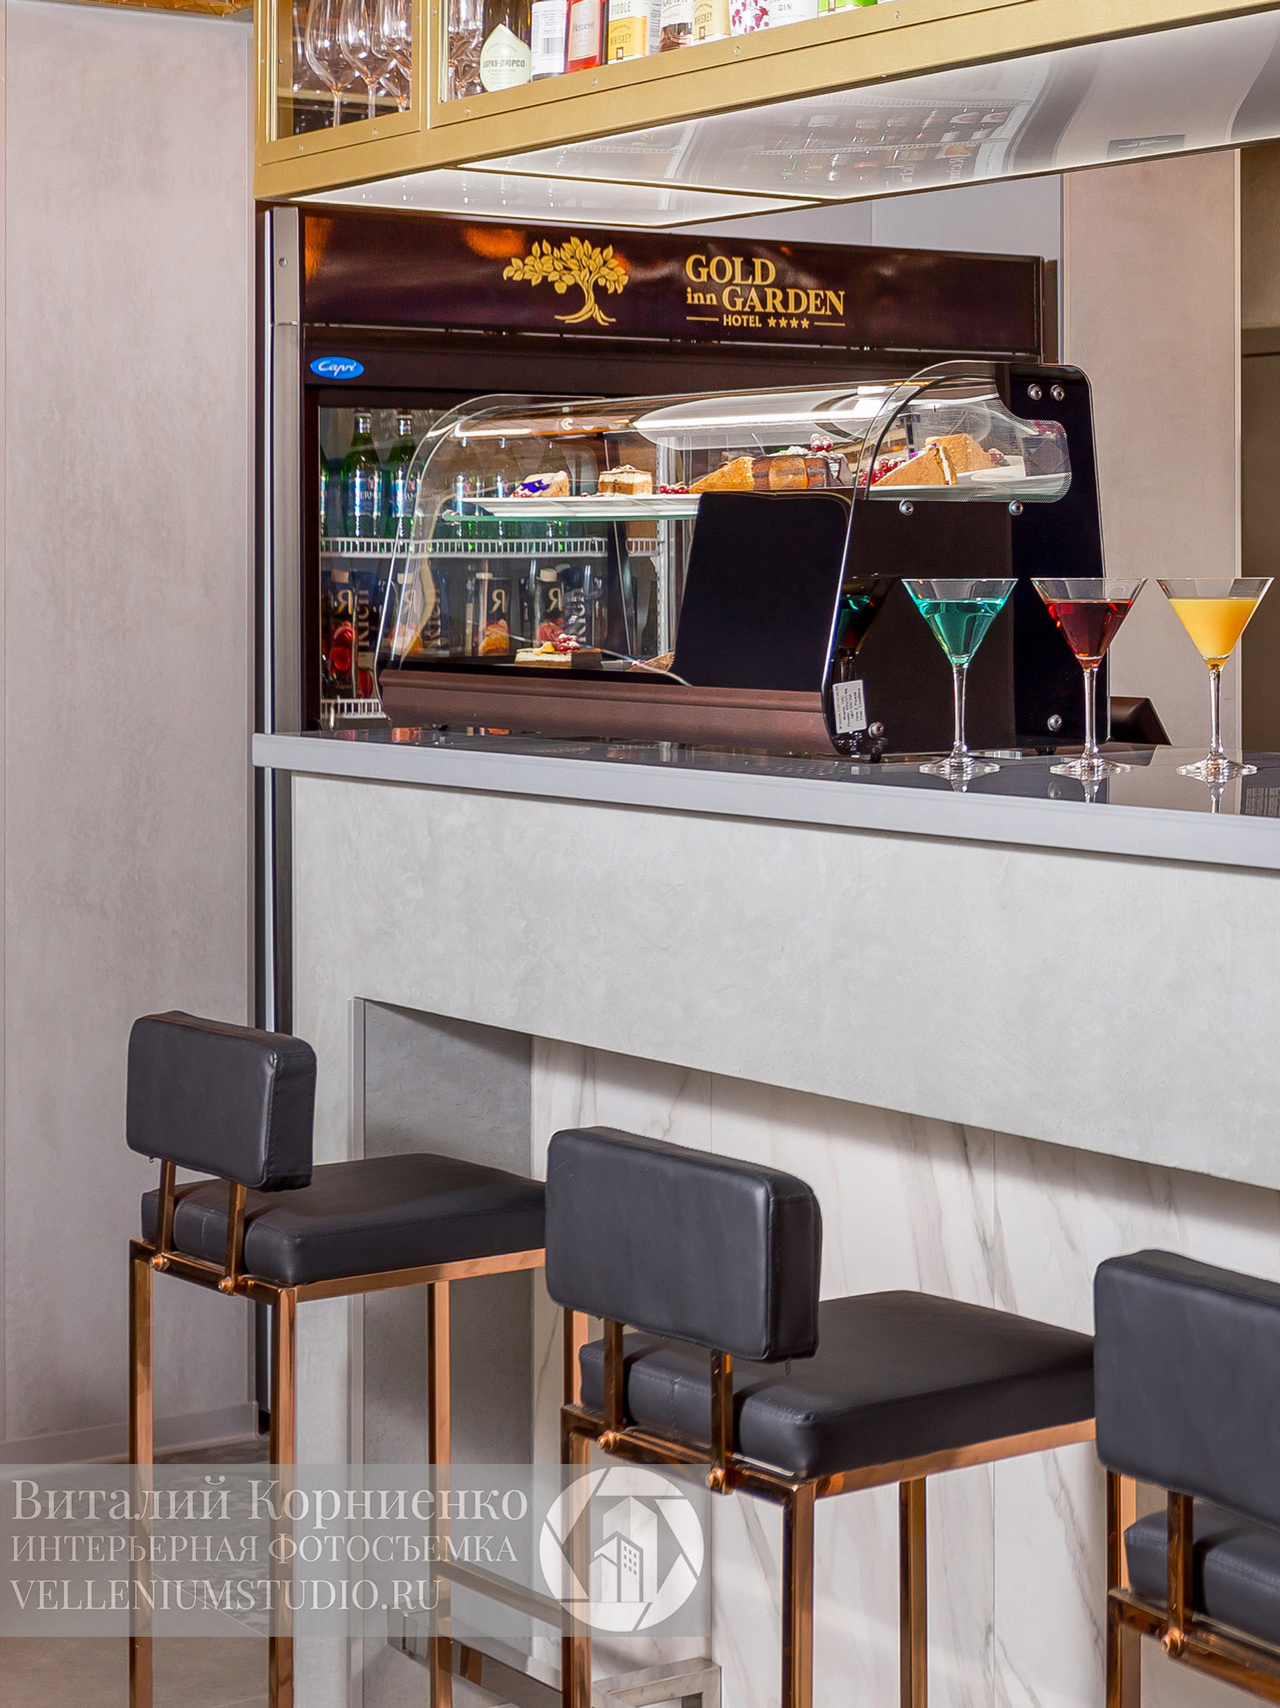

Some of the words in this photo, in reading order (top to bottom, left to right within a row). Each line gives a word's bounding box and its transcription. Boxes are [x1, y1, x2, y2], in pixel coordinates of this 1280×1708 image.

[778, 3, 792, 12] GIN
[685, 254, 776, 285] GOLD
[686, 287, 718, 305] inn
[721, 286, 845, 316] GARDEN
[723, 314, 762, 328] HOTEL
